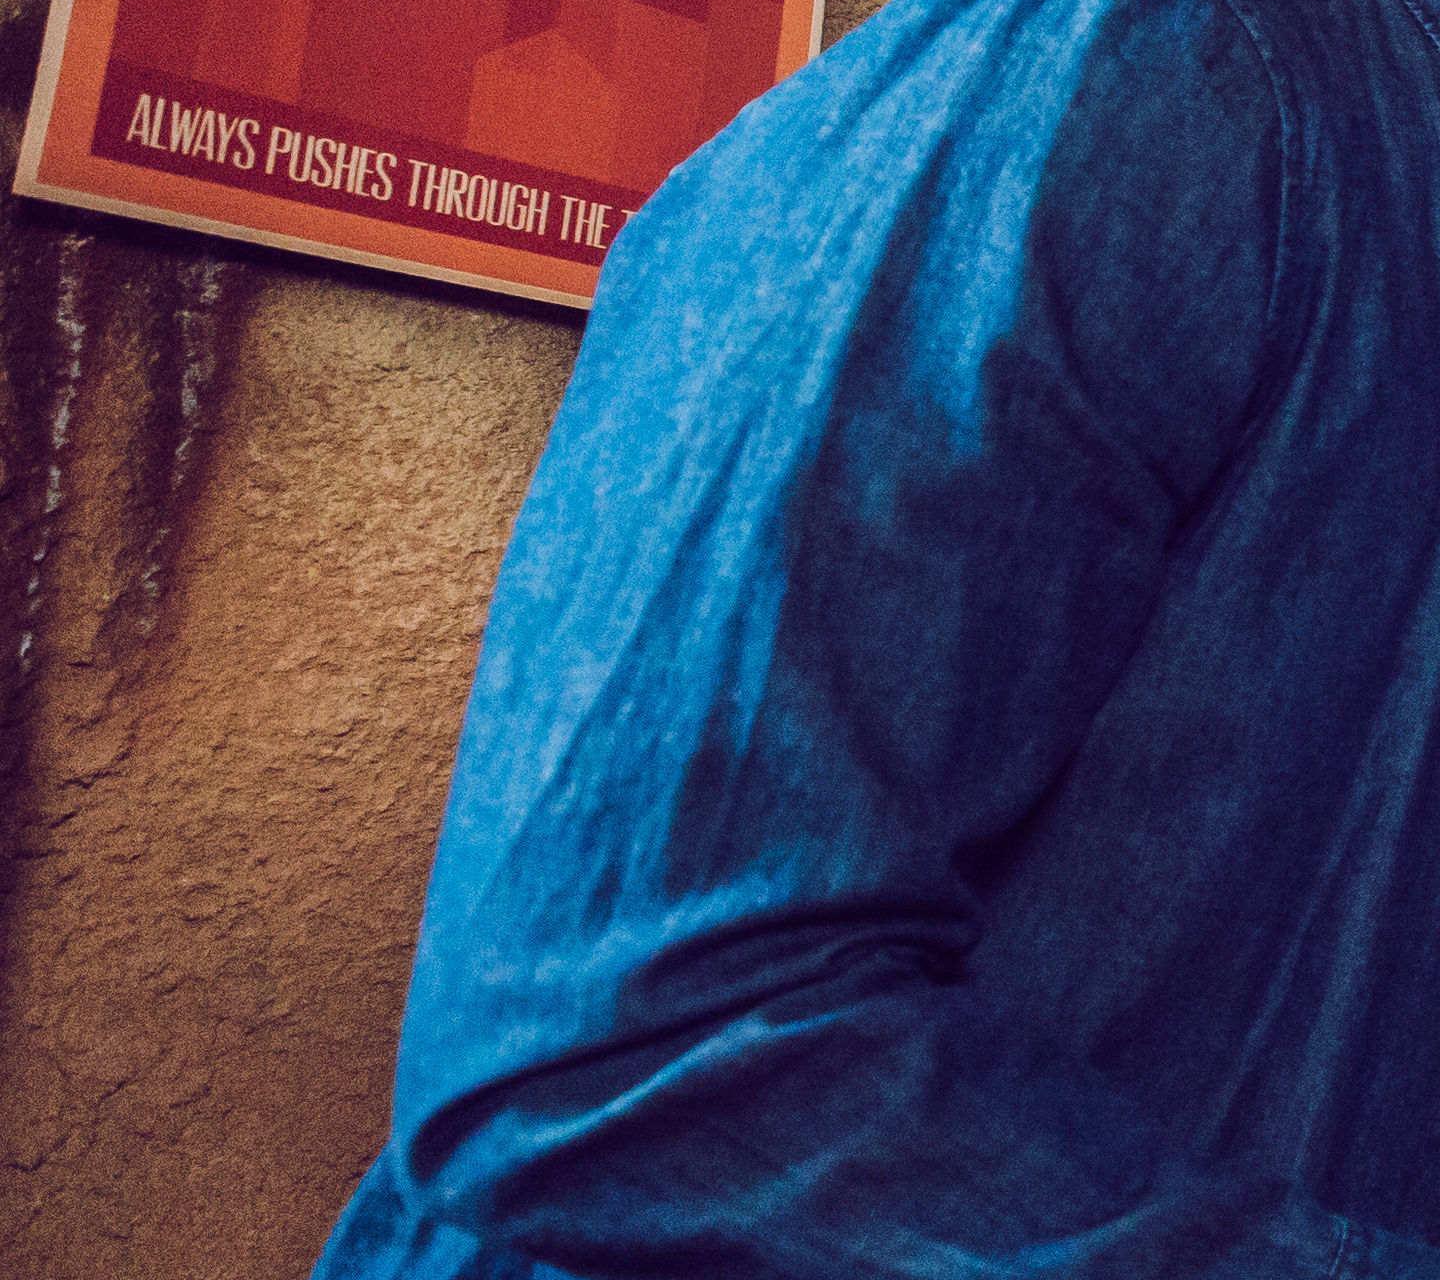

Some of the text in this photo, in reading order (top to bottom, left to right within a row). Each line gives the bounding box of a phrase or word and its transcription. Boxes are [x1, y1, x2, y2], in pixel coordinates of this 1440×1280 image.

[126, 93, 613, 250] ALWAYS PUSHES THROUGH THE
